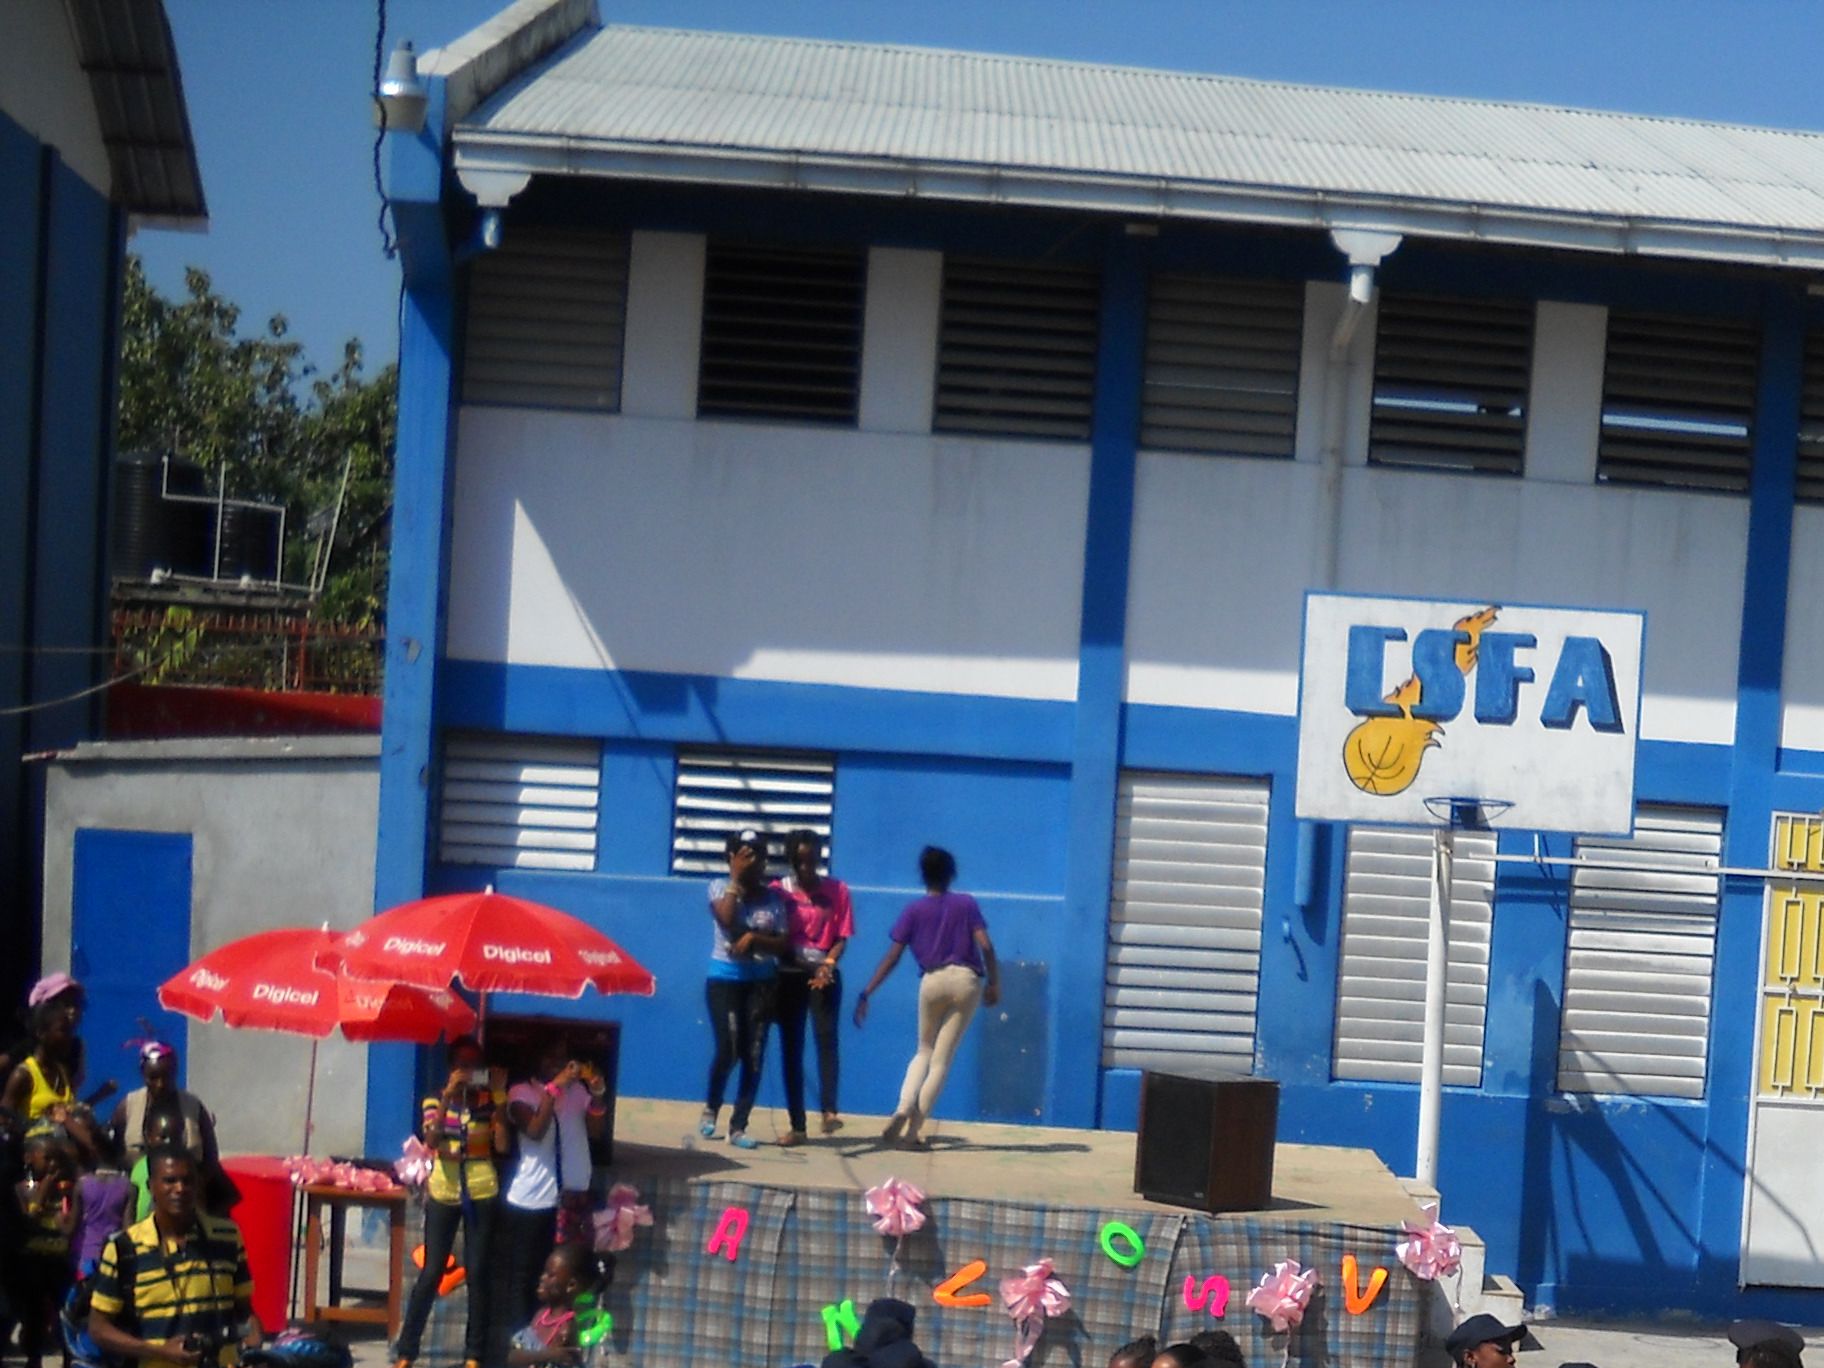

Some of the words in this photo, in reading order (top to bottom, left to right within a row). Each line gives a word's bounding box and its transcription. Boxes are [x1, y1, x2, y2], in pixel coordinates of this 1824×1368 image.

[1344, 624, 1625, 734] CSFA
[383, 937, 447, 957] Digicel
[482, 944, 552, 965] Digicel
[252, 983, 319, 1006] Digicel
